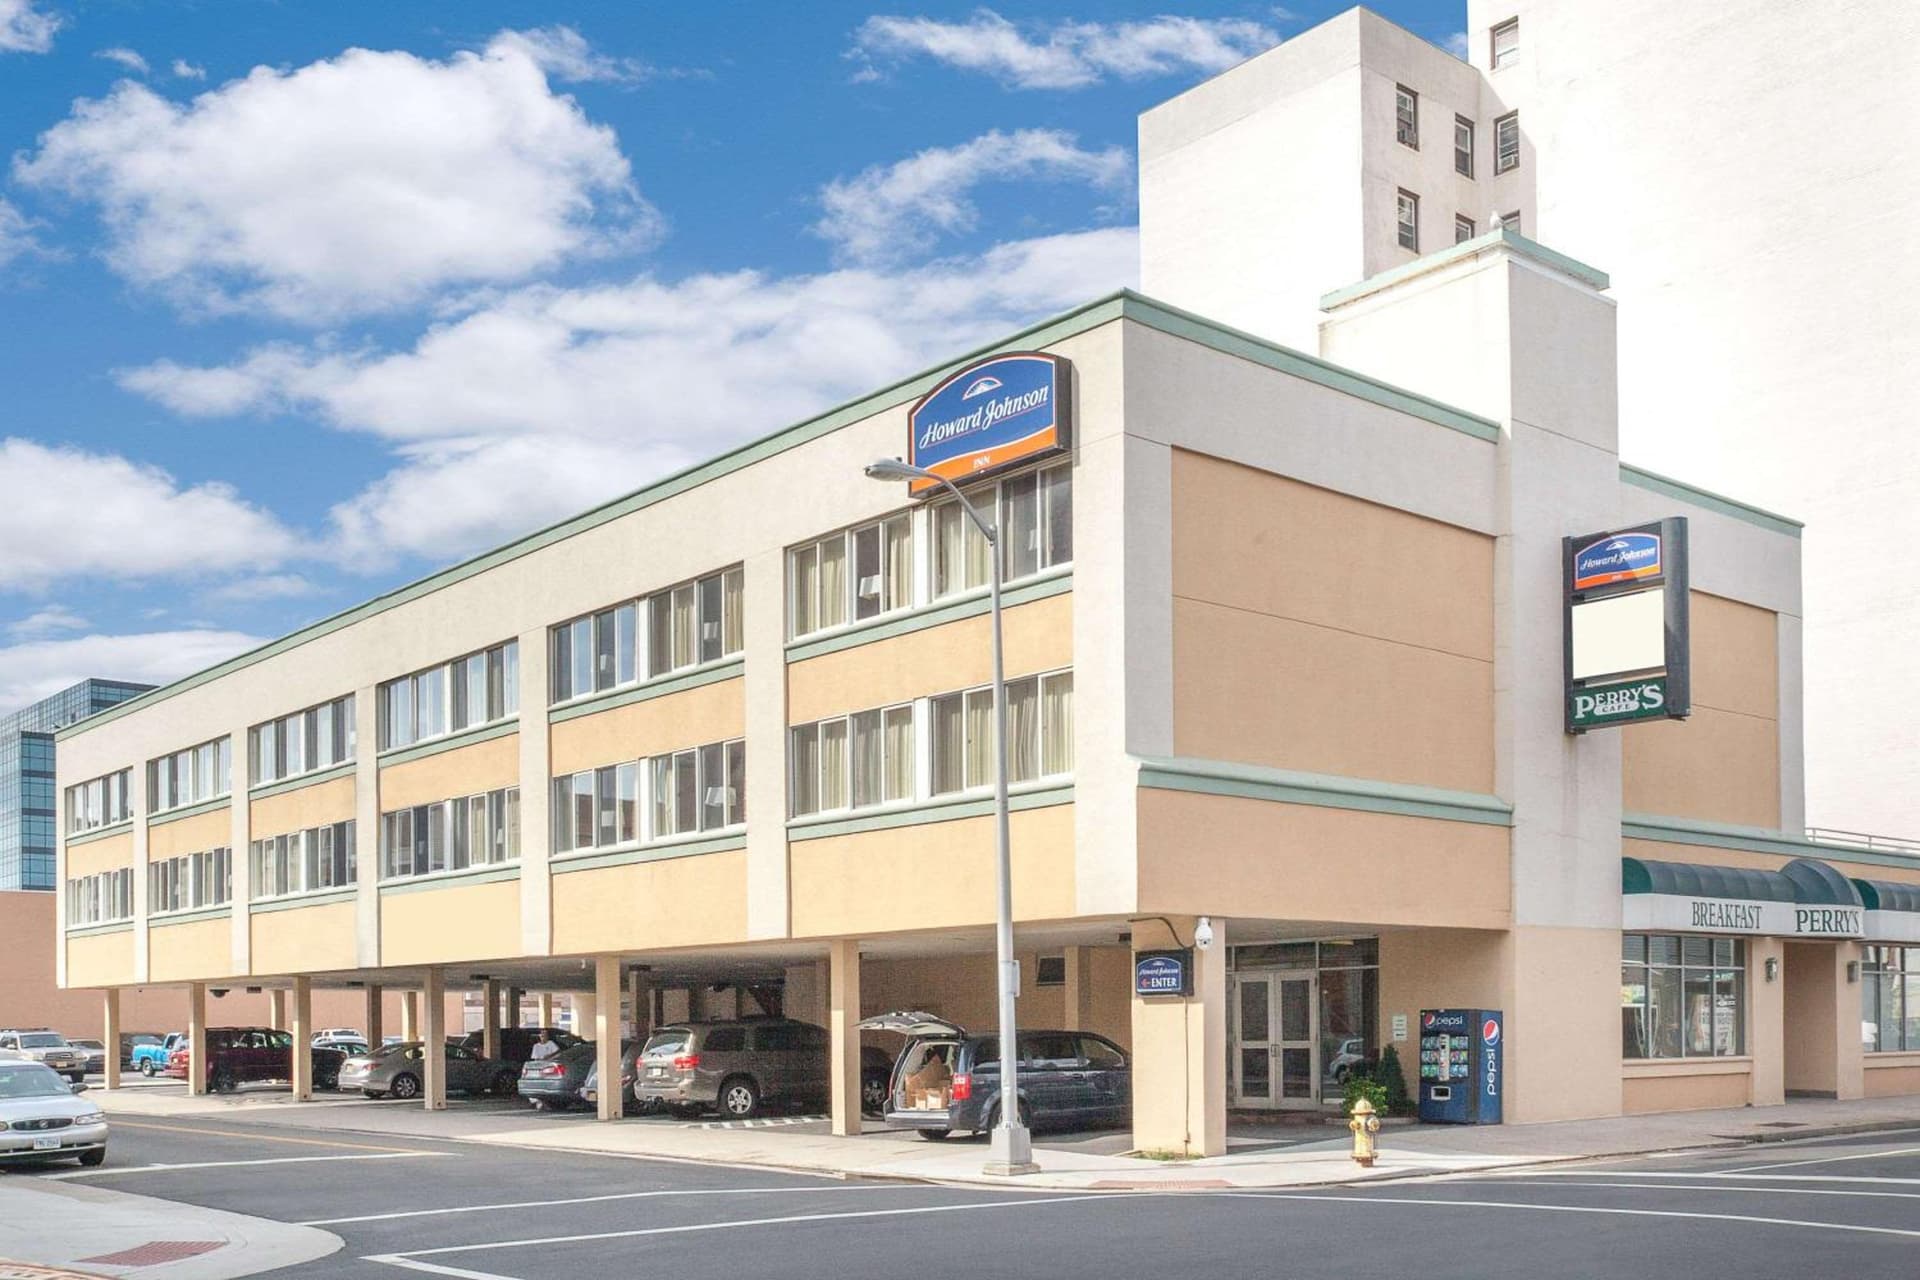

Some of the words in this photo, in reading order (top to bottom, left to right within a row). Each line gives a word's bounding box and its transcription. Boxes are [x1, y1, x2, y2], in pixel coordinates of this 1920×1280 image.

[919, 407, 982, 449] Howard
[982, 385, 1048, 430] Johnson
[973, 456, 990, 468] INN
[1580, 555, 1617, 570] Howard
[1617, 547, 1655, 564] Johnson
[1575, 684, 1664, 719] PERRY'S
[1602, 703, 1630, 713] CAFE
[1692, 902, 1762, 929] BREAKFAST
[1795, 909, 1859, 933] PERRY'S
[1151, 977, 1177, 988] ENTER
[1436, 1015, 1463, 1026] pepsi
[1485, 1048, 1497, 1096] pepsi
